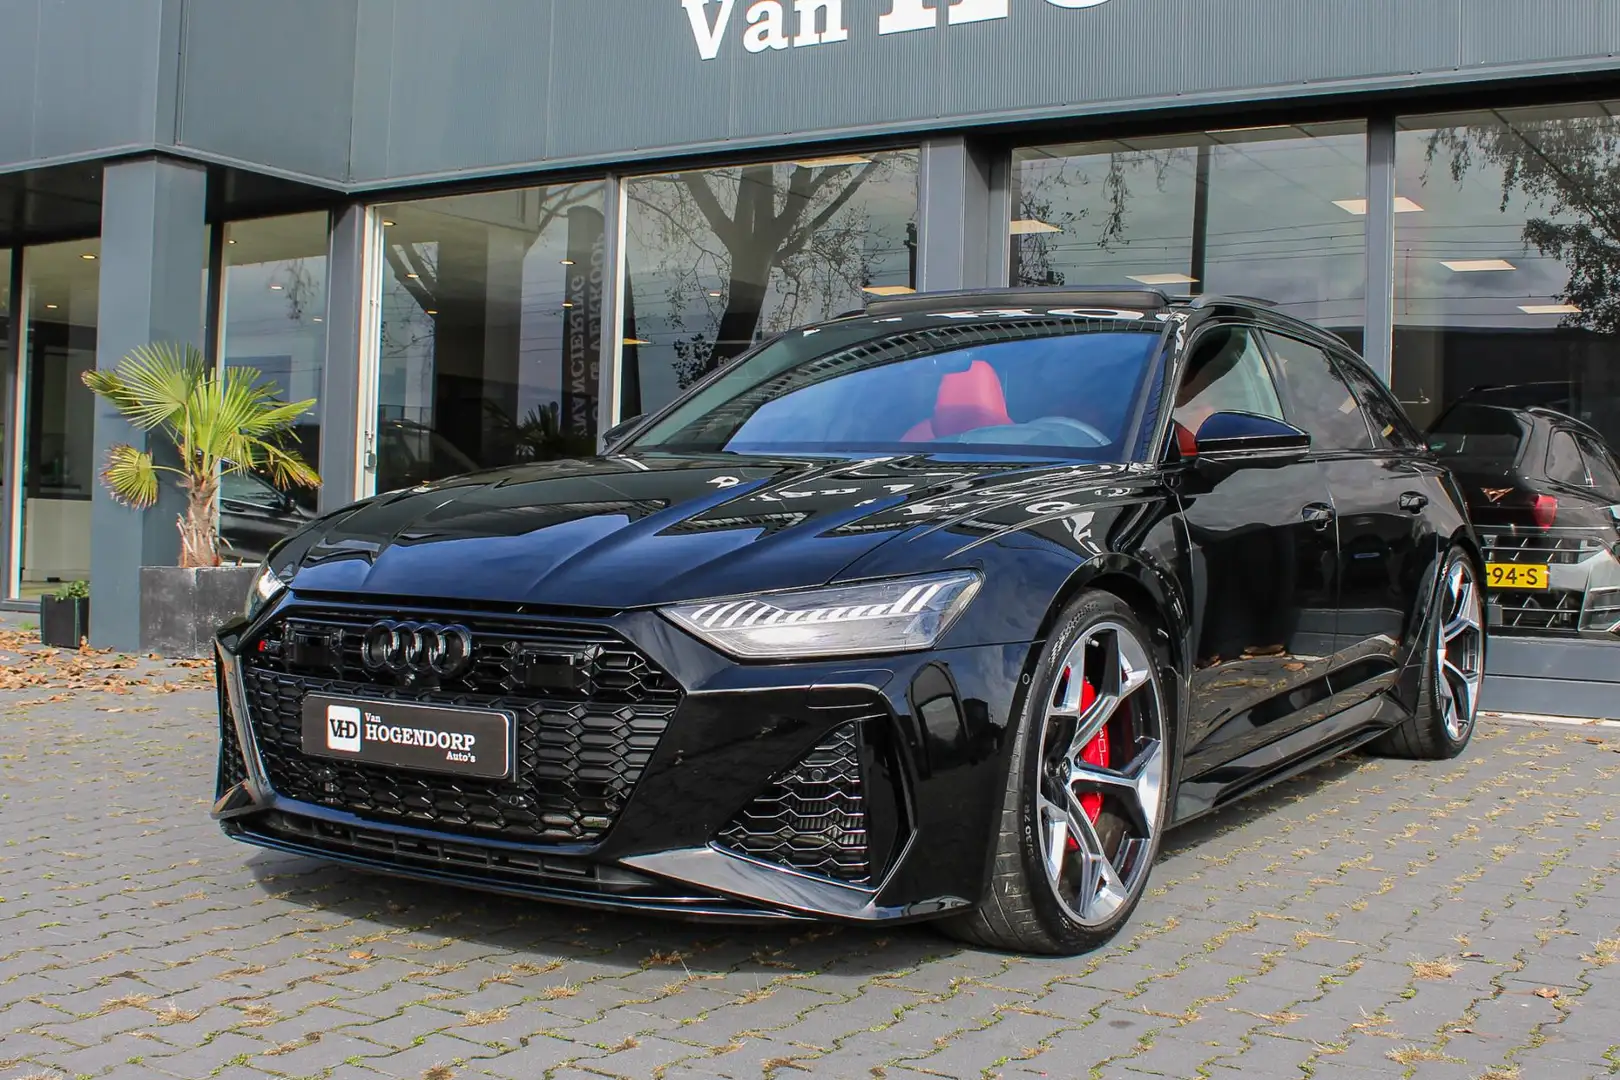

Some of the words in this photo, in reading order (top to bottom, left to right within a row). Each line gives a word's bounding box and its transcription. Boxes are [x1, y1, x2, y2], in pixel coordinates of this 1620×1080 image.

[682, 0, 848, 61] Van
[364, 712, 381, 723] Van
[329, 719, 358, 739] VHD
[364, 723, 476, 751] HOGENDORP
[446, 751, 476, 763] Auto's
